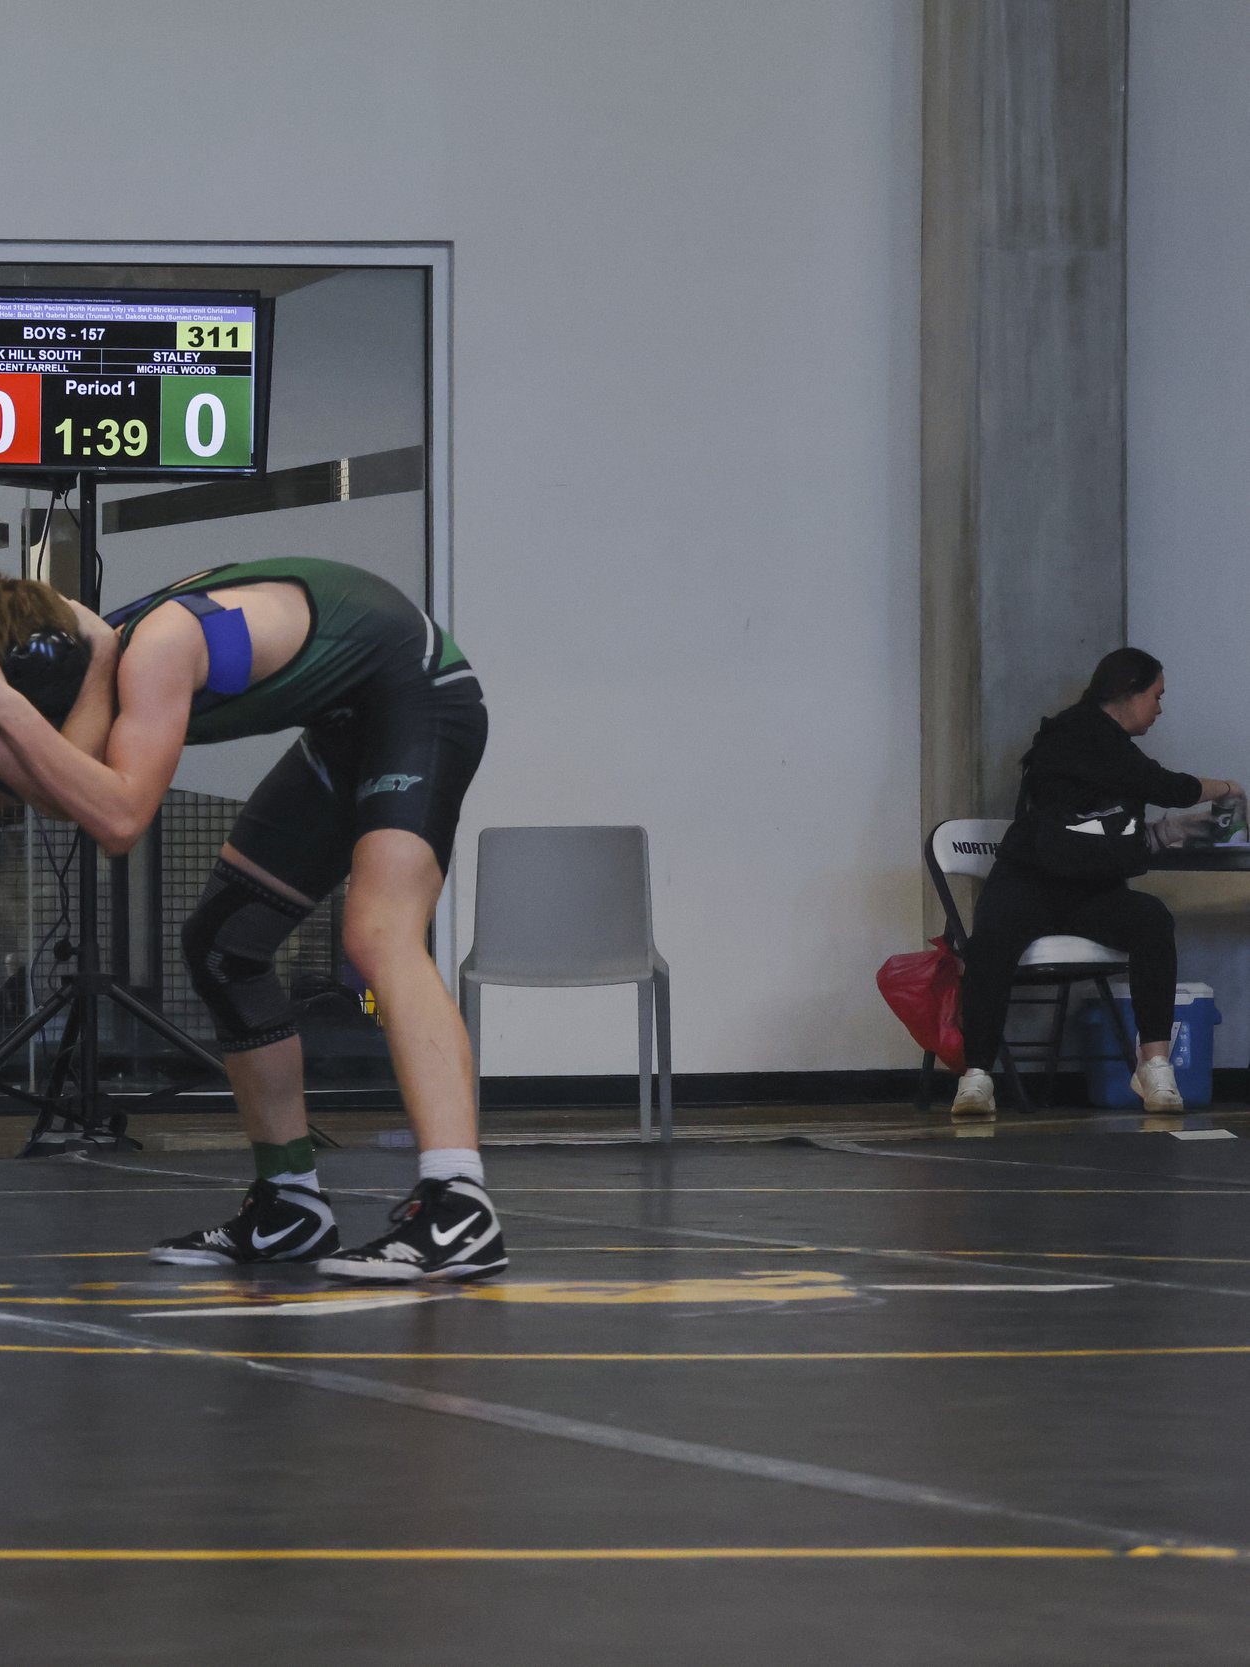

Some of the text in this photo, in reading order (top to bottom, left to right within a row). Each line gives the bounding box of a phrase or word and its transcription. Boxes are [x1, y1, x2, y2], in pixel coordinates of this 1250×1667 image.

[23, 327, 66, 340] BOYS
[80, 328, 105, 340] 157
[188, 326, 238, 348] 311
[8, 349, 35, 360] HILL
[38, 350, 81, 361] SOUTH
[153, 352, 200, 362] STALEY
[26, 364, 69, 372] FARRELL
[137, 365, 217, 375] MICHAEL WOODS
[66, 380, 136, 396] Period 1
[184, 393, 227, 457] 0
[54, 418, 149, 457] 1:39
